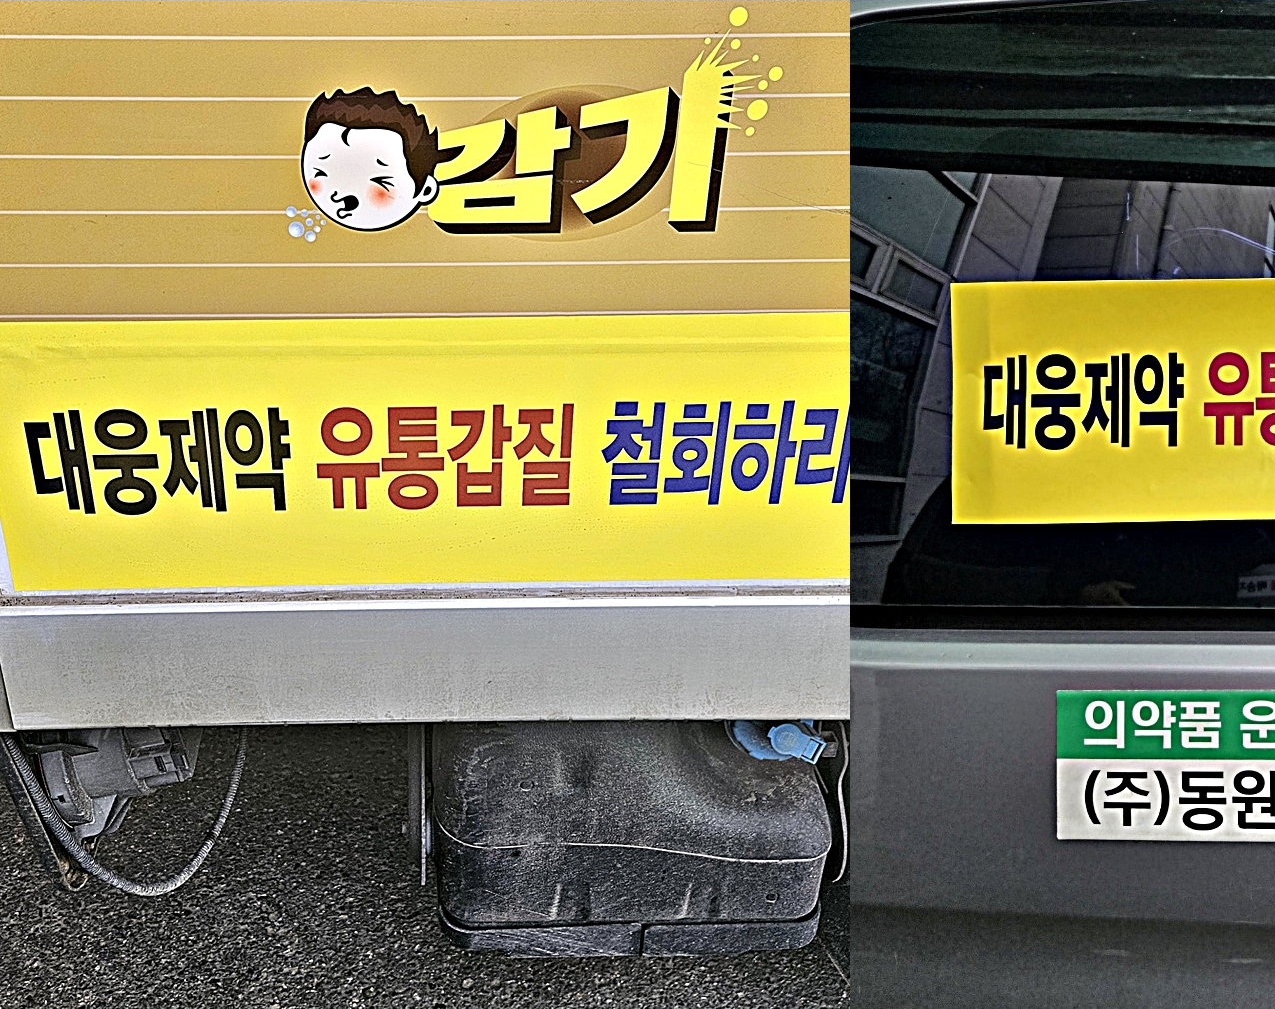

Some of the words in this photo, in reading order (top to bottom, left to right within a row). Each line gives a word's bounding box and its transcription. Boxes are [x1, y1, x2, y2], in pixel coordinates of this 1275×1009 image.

[430, 68, 732, 234] 감기
[983, 352, 1185, 451] 대웅제약
[23, 407, 292, 516] 대웅제약
[316, 403, 575, 511] 유통갑질
[1083, 700, 1222, 749] 의약품
